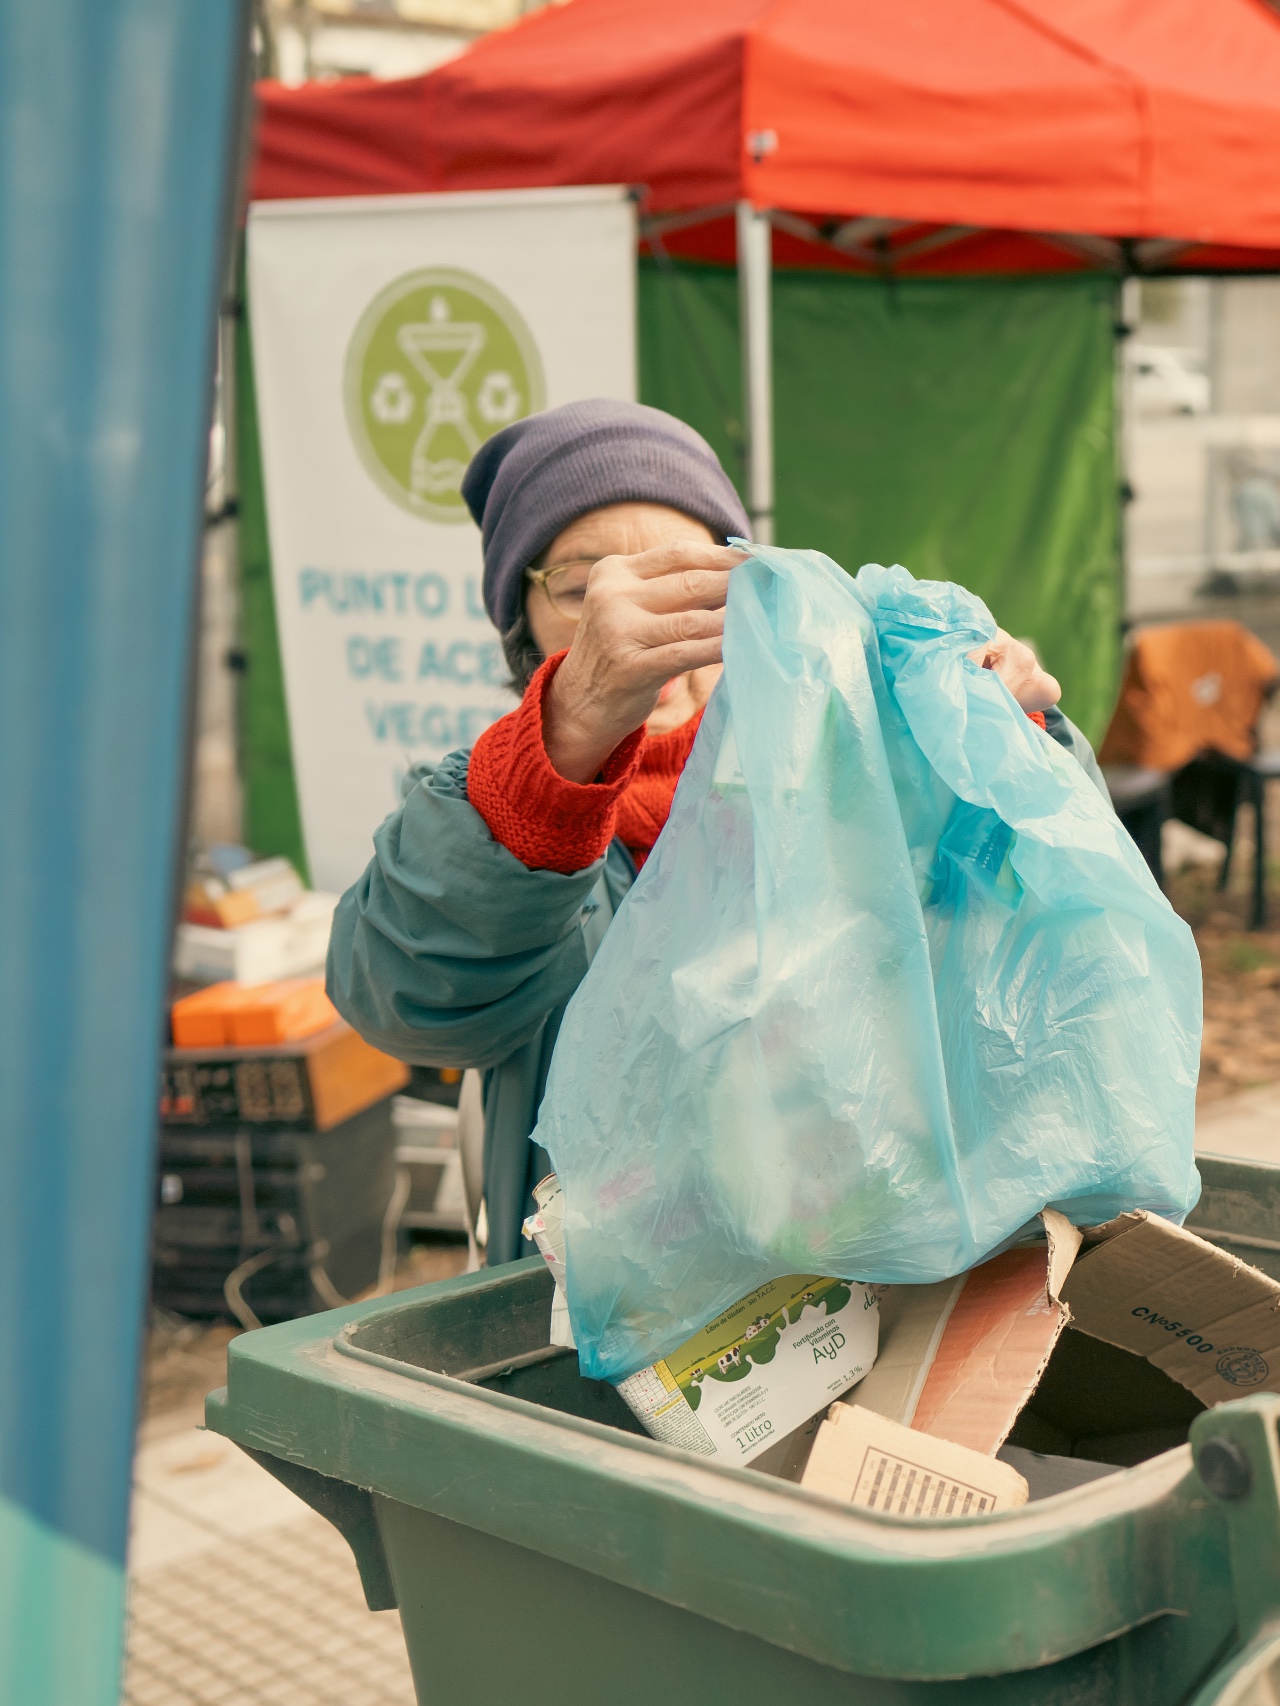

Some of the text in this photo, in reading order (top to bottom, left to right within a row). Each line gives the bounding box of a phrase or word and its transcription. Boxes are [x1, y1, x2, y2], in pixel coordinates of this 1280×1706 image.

[298, 567, 487, 619] PUNTO L
[346, 633, 503, 686] DE ACE
[364, 699, 511, 747] VEGE
[705, 1322, 720, 1334] Libre
[720, 1316, 727, 1325] de
[727, 1305, 745, 1320] Gluten
[748, 1297, 758, 1306] Sin
[792, 1318, 836, 1350] Fortificada con
[808, 1325, 840, 1347] Vitaminas
[843, 1365, 862, 1382] 1,3%
[730, 1412, 766, 1439] CONTENIDO NETO
[736, 1420, 772, 1449] 1 litro
